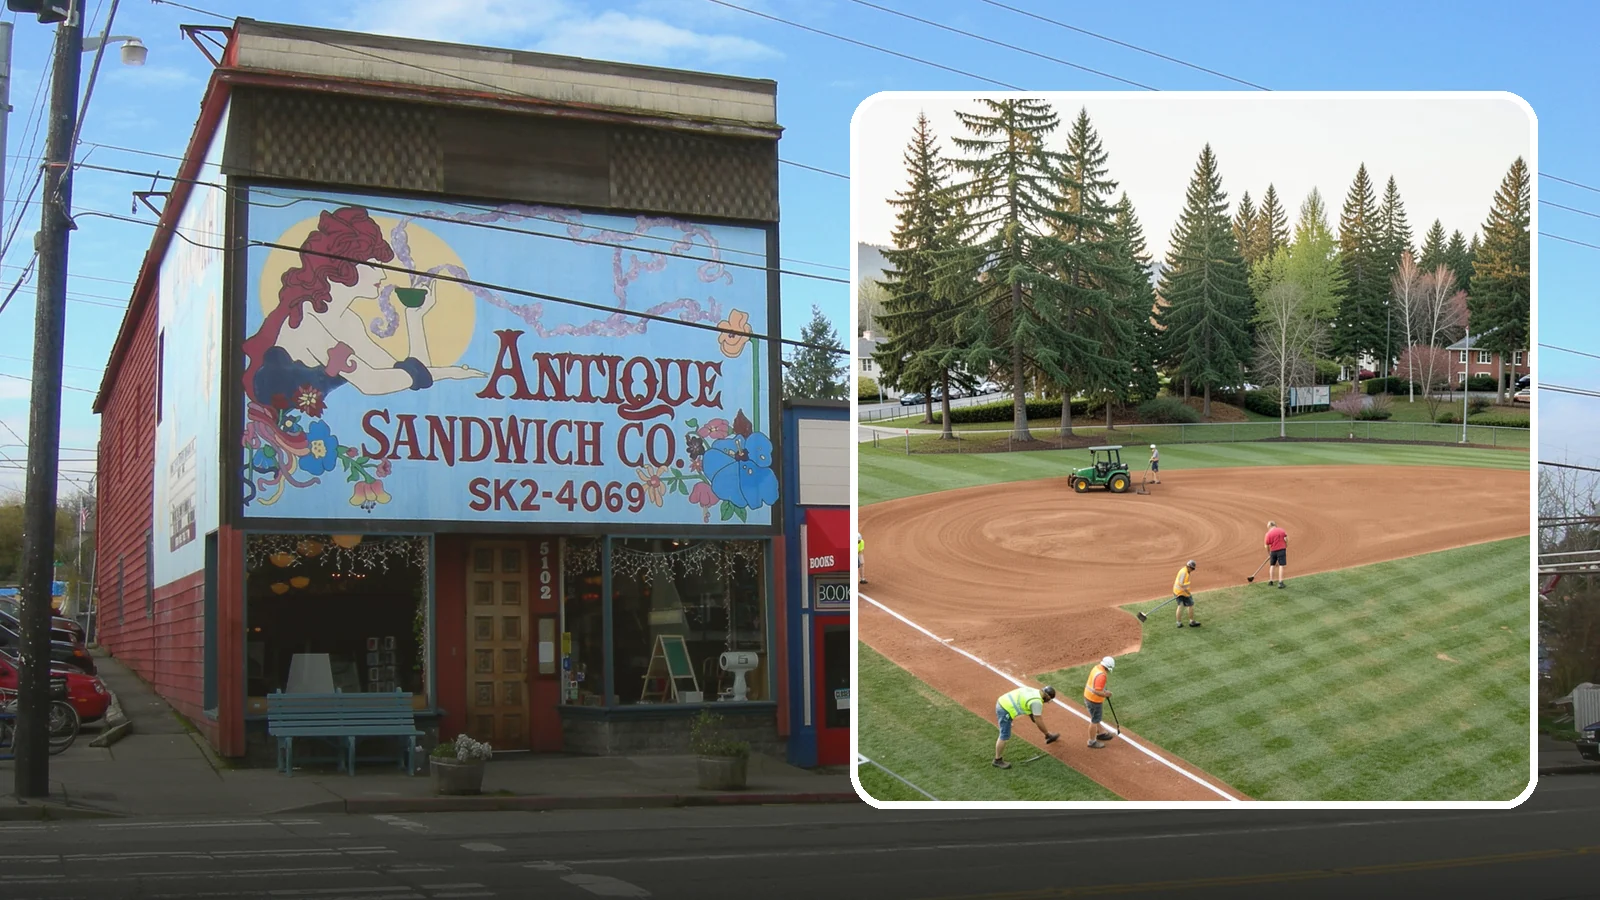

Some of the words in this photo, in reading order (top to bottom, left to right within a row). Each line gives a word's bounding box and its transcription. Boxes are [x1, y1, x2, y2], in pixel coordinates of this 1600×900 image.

[476, 329, 724, 421] ANTIQUE
[361, 408, 604, 467] SANDWICH
[617, 421, 685, 469] CO.
[468, 477, 646, 513] SK2-4069
[540, 541, 551, 600] 5102
[809, 555, 835, 569] BOOKS
